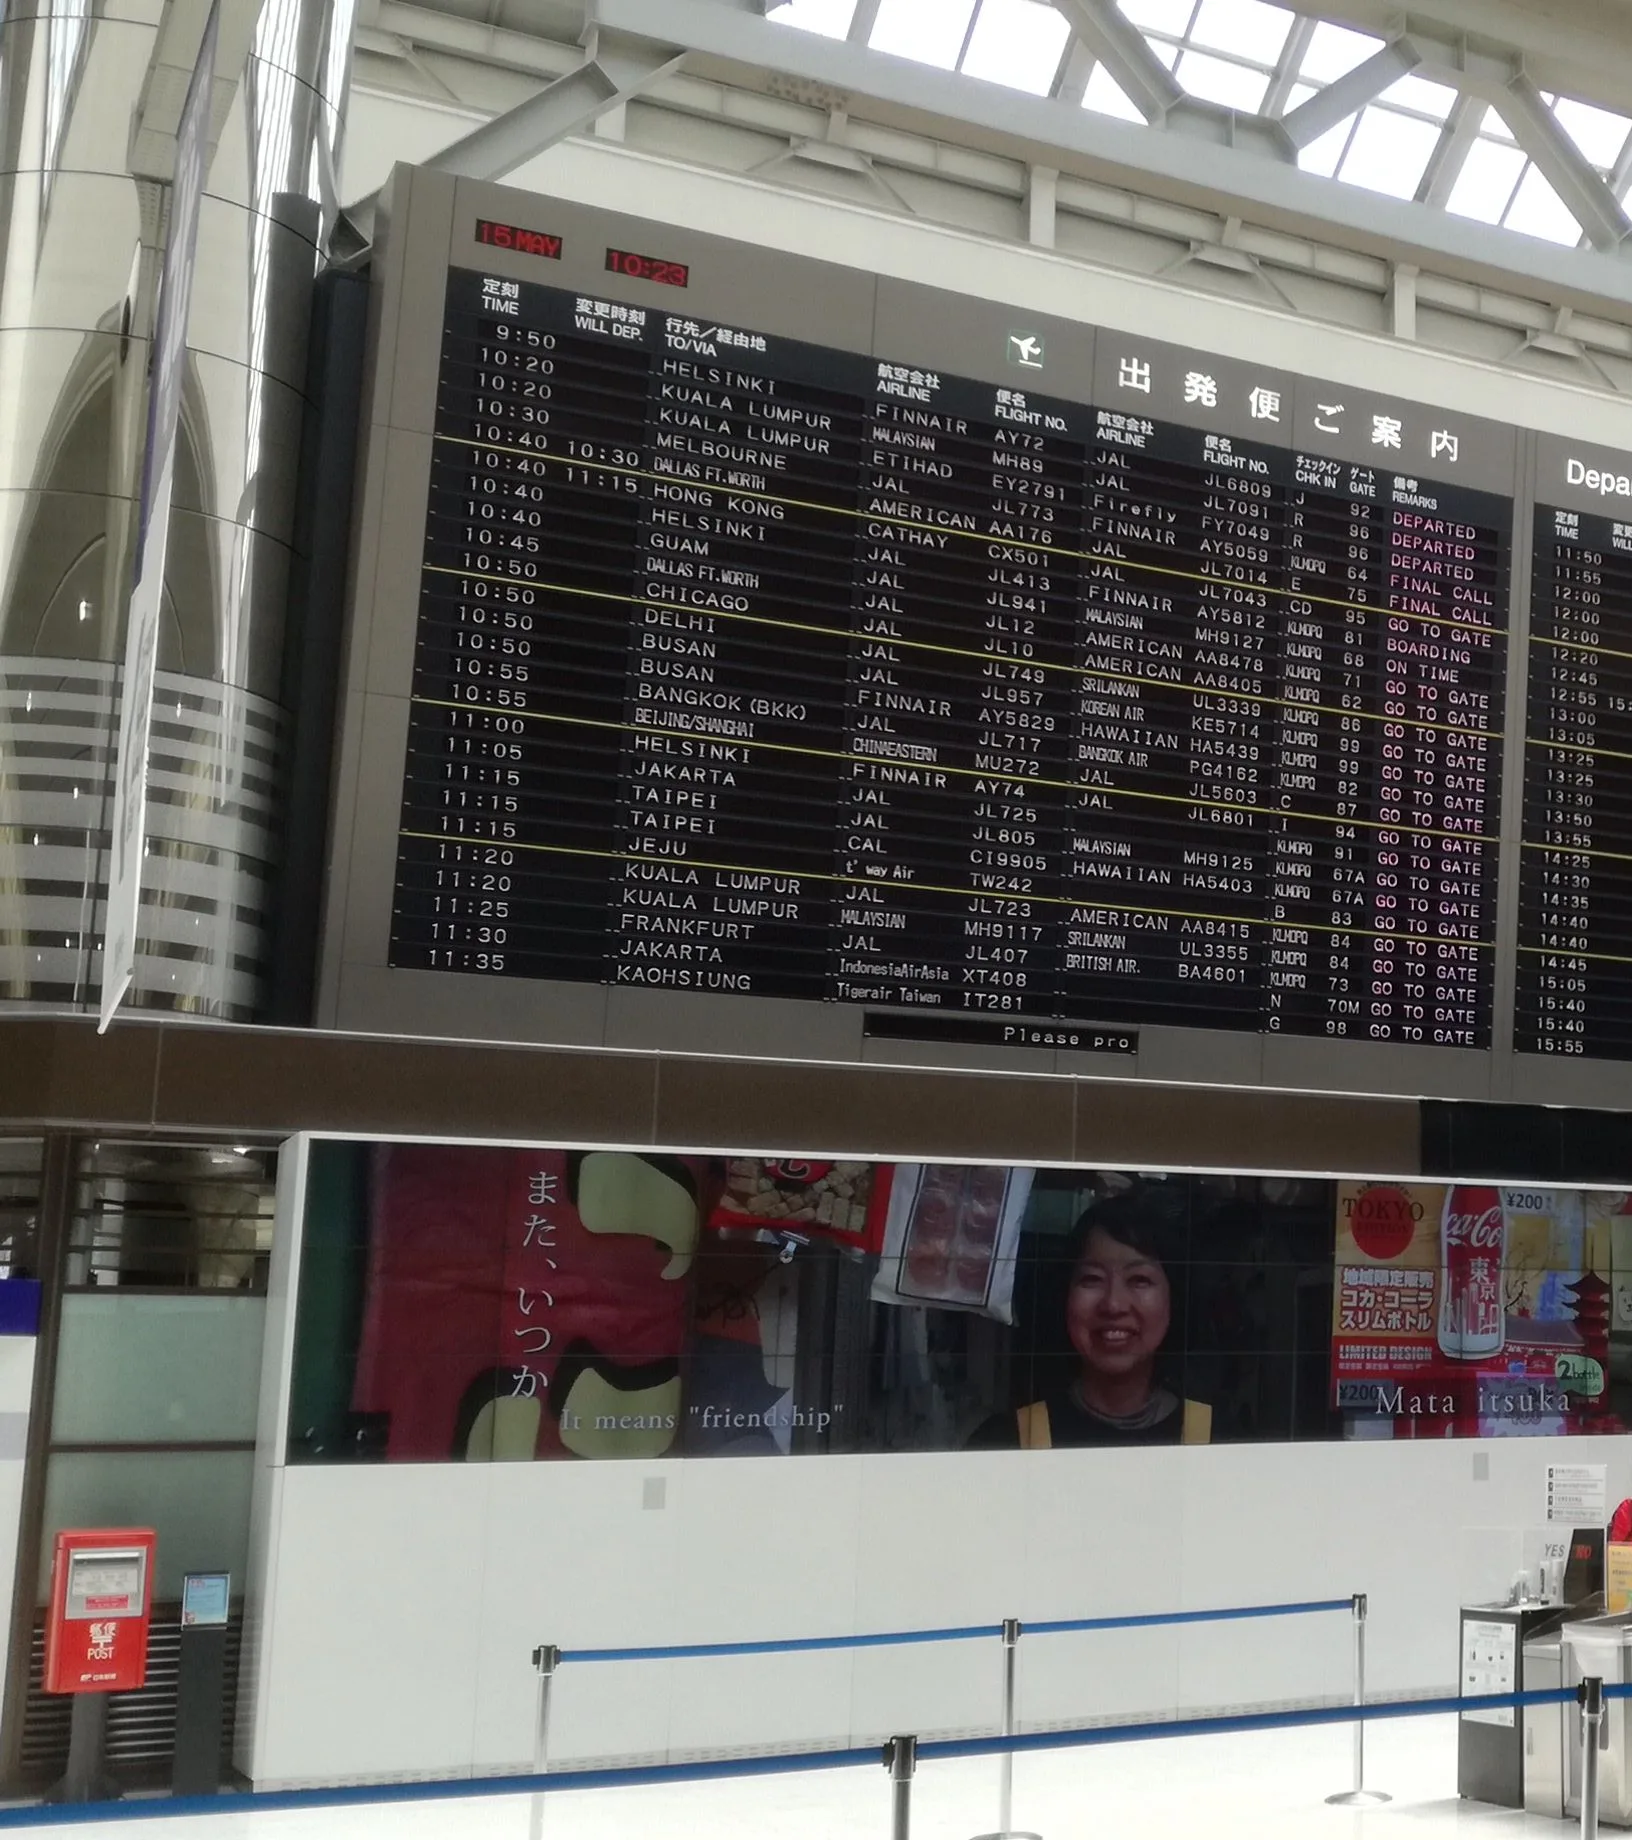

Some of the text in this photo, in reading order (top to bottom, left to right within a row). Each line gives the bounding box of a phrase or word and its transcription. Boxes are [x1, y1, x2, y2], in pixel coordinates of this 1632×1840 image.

[610, 252, 686, 285] 10:23
[483, 278, 519, 299] 定刻
[482, 296, 519, 315] TIME
[576, 298, 645, 326] 変更時刻
[496, 325, 555, 349] 9:50
[575, 315, 643, 341] WILL DEP.
[665, 334, 717, 357] TO/VIA
[480, 347, 553, 375] 10:20
[478, 373, 551, 400] 10:20
[663, 359, 776, 394] HELSINKI
[878, 364, 940, 390] 航空会社
[877, 381, 931, 402] AIRLINE
[996, 390, 1026, 409] 便名
[476, 398, 549, 424] 10:30
[661, 383, 831, 431] KUALA LUMPUR
[876, 404, 967, 434] FINNAIR
[995, 405, 1067, 432] FLIGHT NO.
[473, 423, 548, 450] 10:40
[1097, 411, 1154, 437] 航空会社
[995, 430, 1045, 451] AY72
[1096, 426, 1146, 449] AIRLINE
[1205, 435, 1232, 453] 便名
[567, 440, 639, 467] 10:30
[657, 432, 786, 471] MELBOURNE
[1204, 450, 1269, 475] FLIGHT NO.
[872, 451, 952, 479] ETIHAD
[1350, 466, 1375, 484] ゲート
[567, 467, 638, 494] 11:15
[993, 474, 1065, 501] EY2791
[1205, 475, 1272, 498] JL6809
[1295, 469, 1337, 489] CHK IN
[1350, 480, 1376, 498] GATE
[1394, 476, 1419, 494] 備考
[654, 483, 784, 520] HONG KONG
[1093, 494, 1177, 524] Firefly
[1392, 490, 1438, 510] REMARKS
[869, 498, 976, 530] AMERICAN
[1393, 511, 1476, 541] DEPARTED
[1556, 511, 1578, 527] 定刻
[650, 533, 709, 556] GUAM
[868, 523, 948, 550] CATHAY
[1554, 524, 1578, 540] TIME
[1392, 532, 1475, 561] DEPARTED
[1554, 544, 1602, 566] 11:50
[646, 583, 749, 612] CHICAGO
[1390, 575, 1493, 605] FINAL CALL
[644, 608, 715, 633] DELHI
[642, 633, 715, 658] BUSAN
[1387, 638, 1471, 665] BOARDING
[639, 683, 806, 721] BANGKOK (BKK)
[1081, 723, 1178, 749] HAWAIIAN
[444, 762, 520, 787] 11:15
[634, 761, 736, 787] JAKARTA
[631, 786, 716, 810] TAIPEI
[628, 837, 687, 856] JEJU
[433, 895, 509, 919] 11:25
[621, 914, 754, 940] FRANKFURT
[428, 948, 504, 971] 11:35
[965, 945, 1028, 964] JL407
[616, 964, 751, 991] KAOHSIUNG
[1004, 1026, 1130, 1049] Please pro
[1370, 1023, 1475, 1045] GO TO GATE
[1536, 1036, 1584, 1056] 15:55
[1343, 1198, 1424, 1222] TOKYO
[1507, 1193, 1542, 1209] ¥200
[1342, 1310, 1432, 1330] スリムボトル
[1339, 1344, 1432, 1360] LIMITED DESIGN
[1376, 1386, 1455, 1414] Mata
[1478, 1384, 1571, 1413] itsuka
[560, 1405, 845, 1433] It means "friendship"
[1545, 1544, 1565, 1558] YES
[87, 1647, 114, 1660] POST
